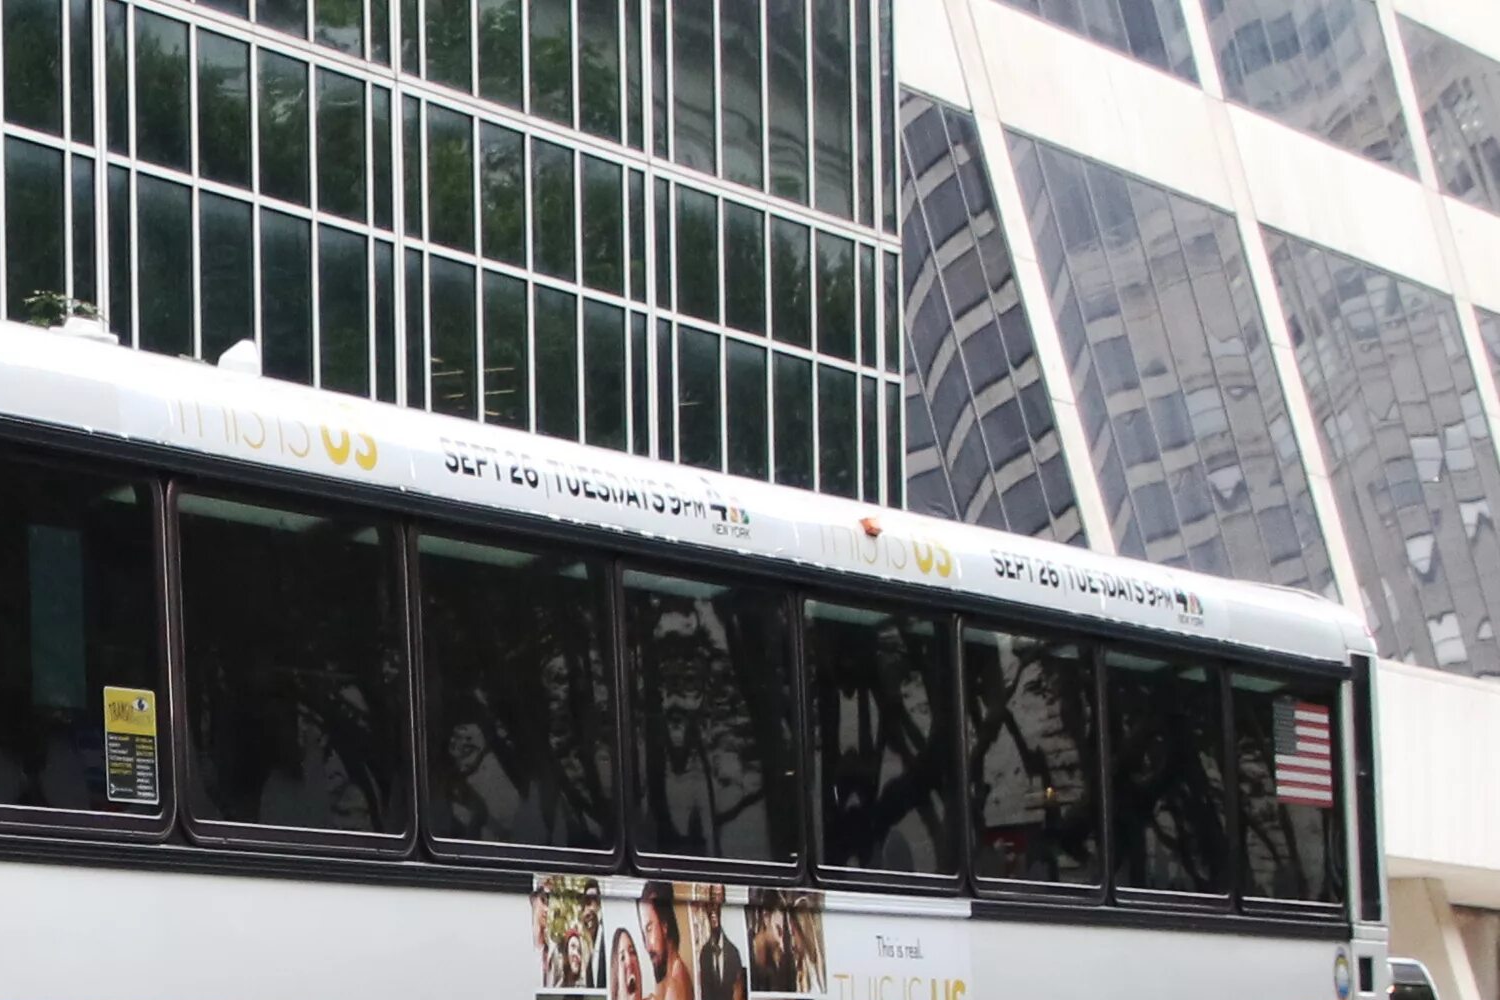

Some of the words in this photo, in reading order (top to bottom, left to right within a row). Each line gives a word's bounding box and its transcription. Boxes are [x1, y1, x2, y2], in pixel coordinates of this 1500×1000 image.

[440, 438, 501, 480] SEPT
[504, 449, 539, 488] 26
[991, 550, 1034, 582] SEPT
[1034, 558, 1060, 588] 26
[876, 935, 895, 958] This
[895, 937, 904, 958] is
